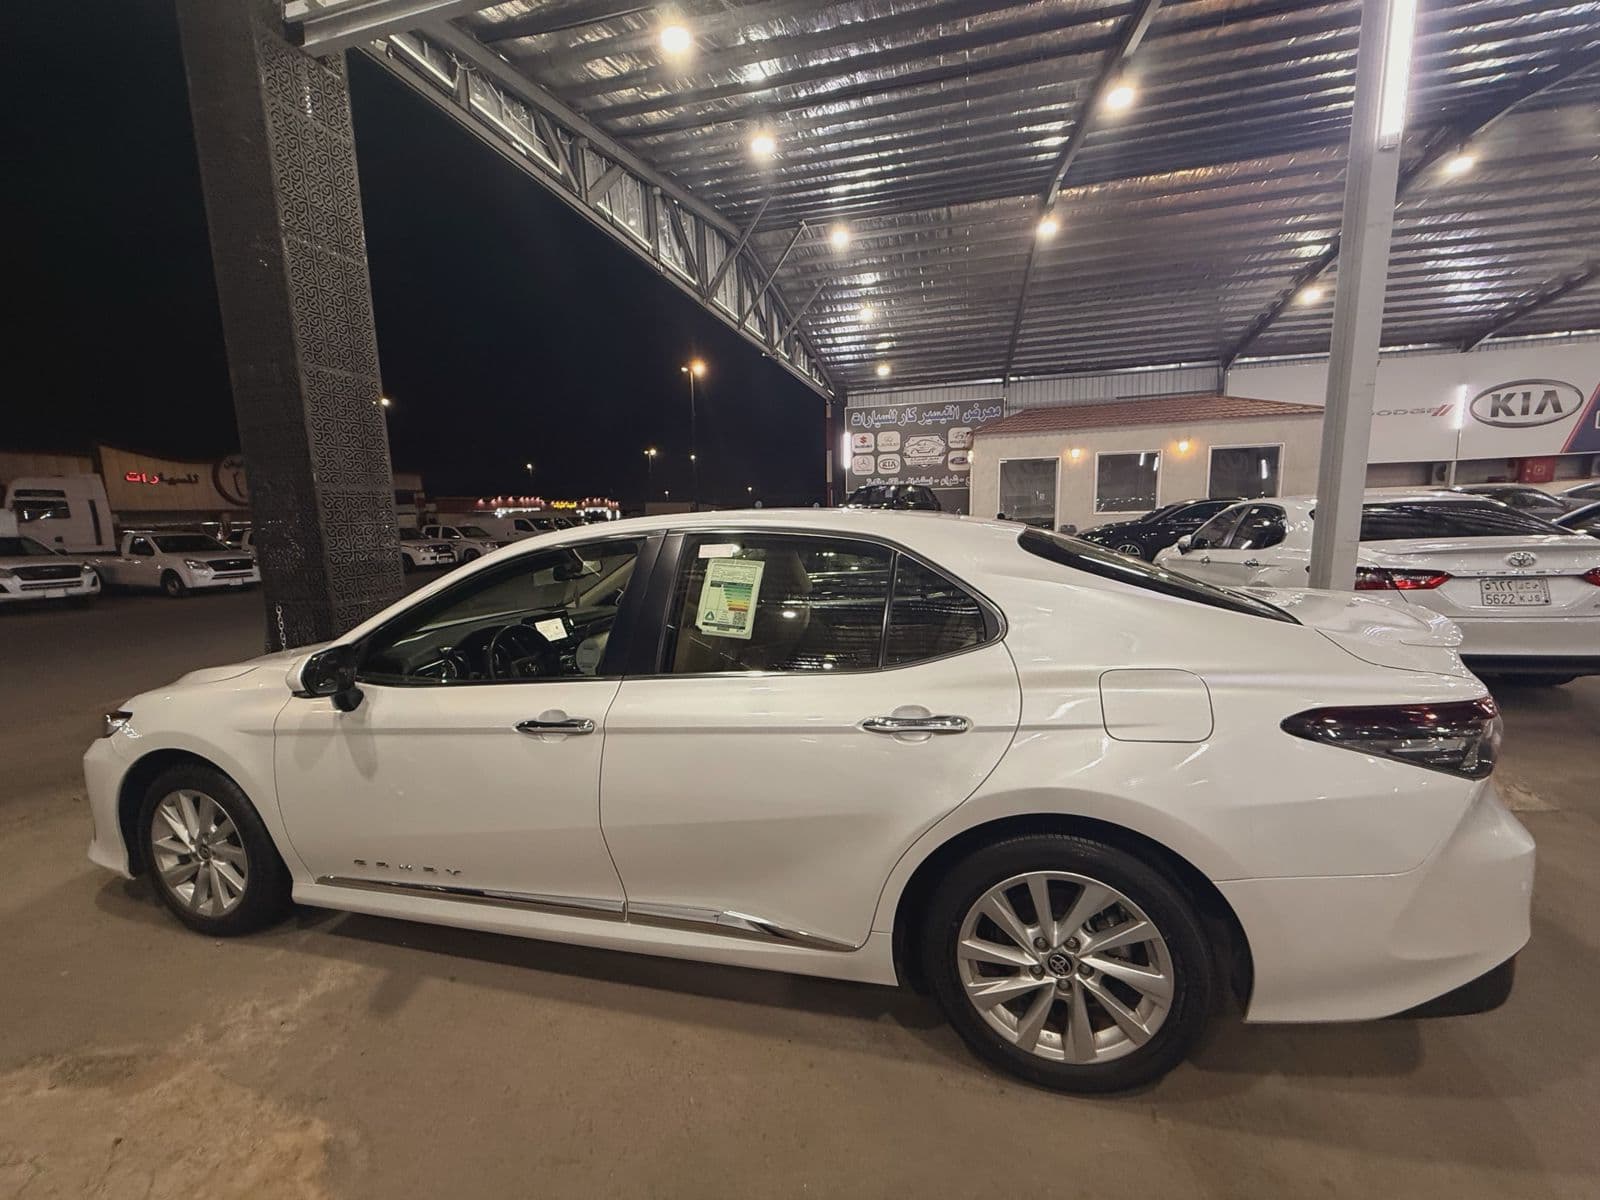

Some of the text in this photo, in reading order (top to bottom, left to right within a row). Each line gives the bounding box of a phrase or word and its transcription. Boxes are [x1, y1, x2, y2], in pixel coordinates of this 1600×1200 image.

[962, 403, 1001, 424] معرض
[1490, 389, 1563, 418] KIA
[851, 409, 898, 428] للسيارات
[898, 406, 917, 427] كار
[1485, 593, 1515, 605] 5622
